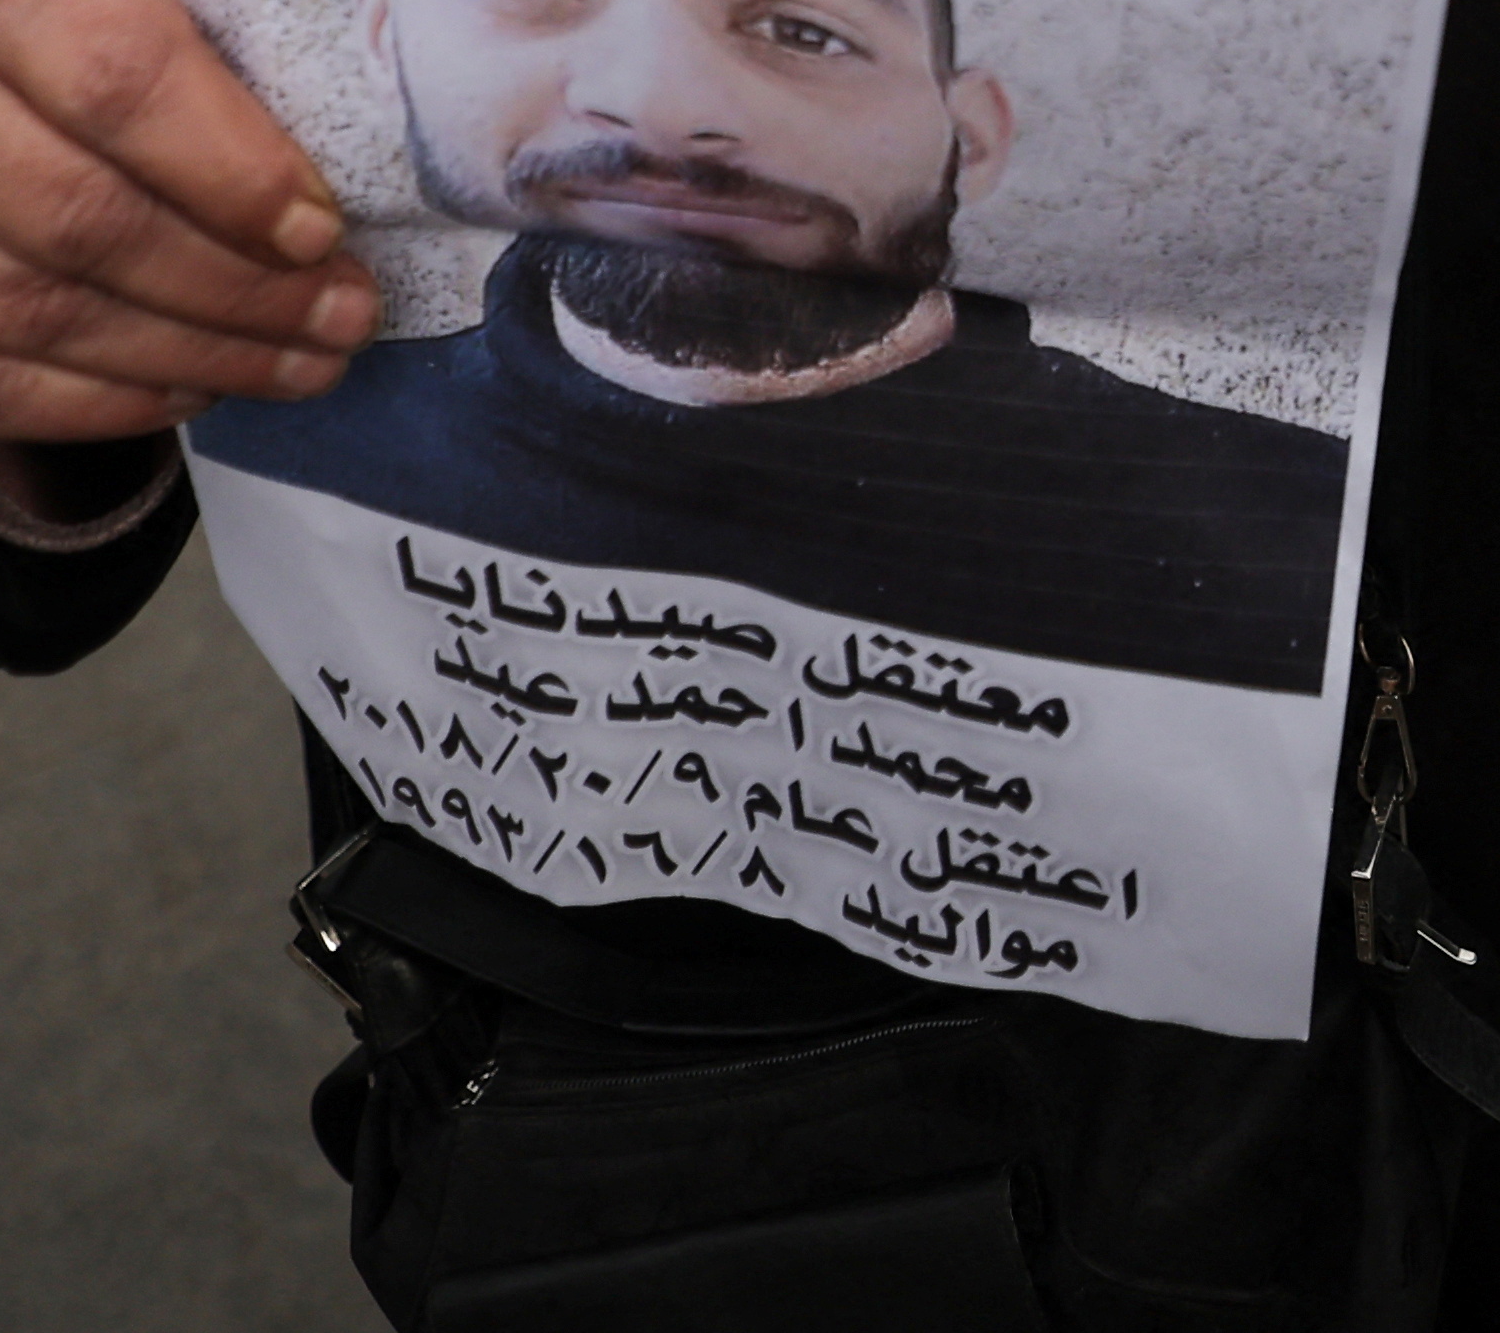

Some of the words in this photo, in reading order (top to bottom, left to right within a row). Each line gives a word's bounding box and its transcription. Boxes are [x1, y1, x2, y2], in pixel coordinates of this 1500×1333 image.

[395, 535, 778, 662] صيدنايا
[434, 635, 580, 726] عيد
[604, 671, 806, 753] احمد
[802, 633, 1071, 739] معتقل
[830, 721, 1034, 814] محمد
[743, 779, 881, 855] عام
[900, 827, 1139, 921] اعتقل
[842, 883, 1080, 980] مواليد
